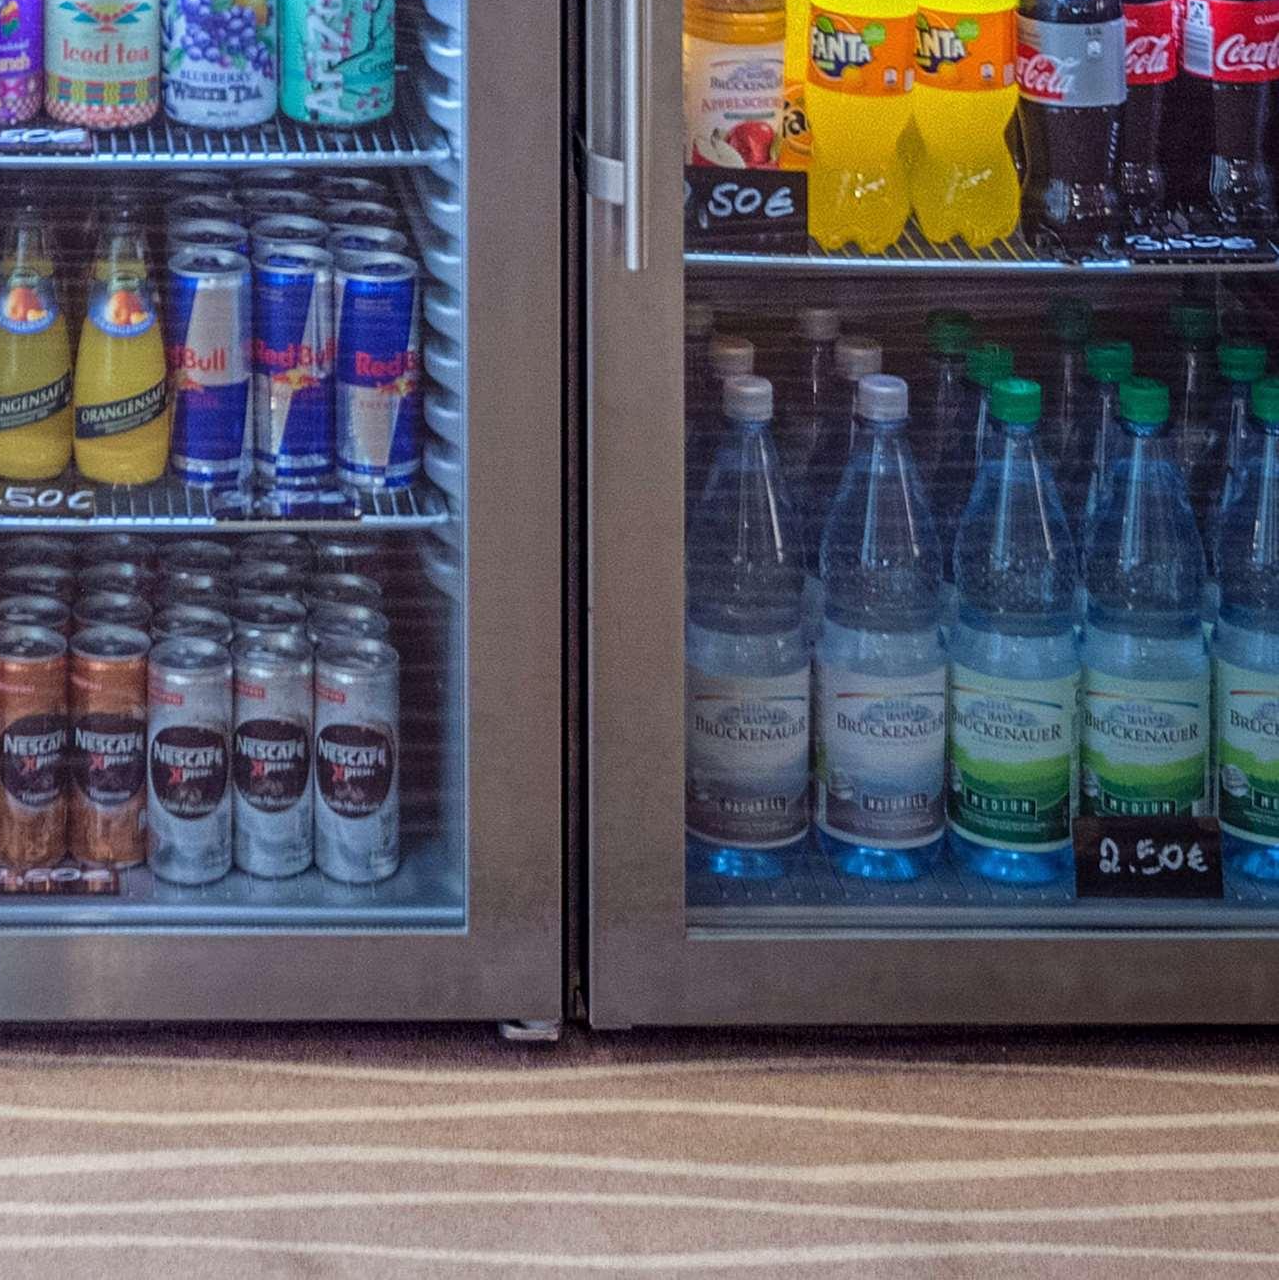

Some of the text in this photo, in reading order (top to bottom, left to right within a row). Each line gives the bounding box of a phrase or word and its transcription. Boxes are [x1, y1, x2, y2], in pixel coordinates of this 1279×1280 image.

[64, 40, 149, 64] Iced tea
[355, 351, 404, 377] Red
[1084, 711, 1200, 742] BRÜCKENAUER
[971, 795, 1029, 812] MEDIUM
[1109, 800, 1170, 814] MEDIUM
